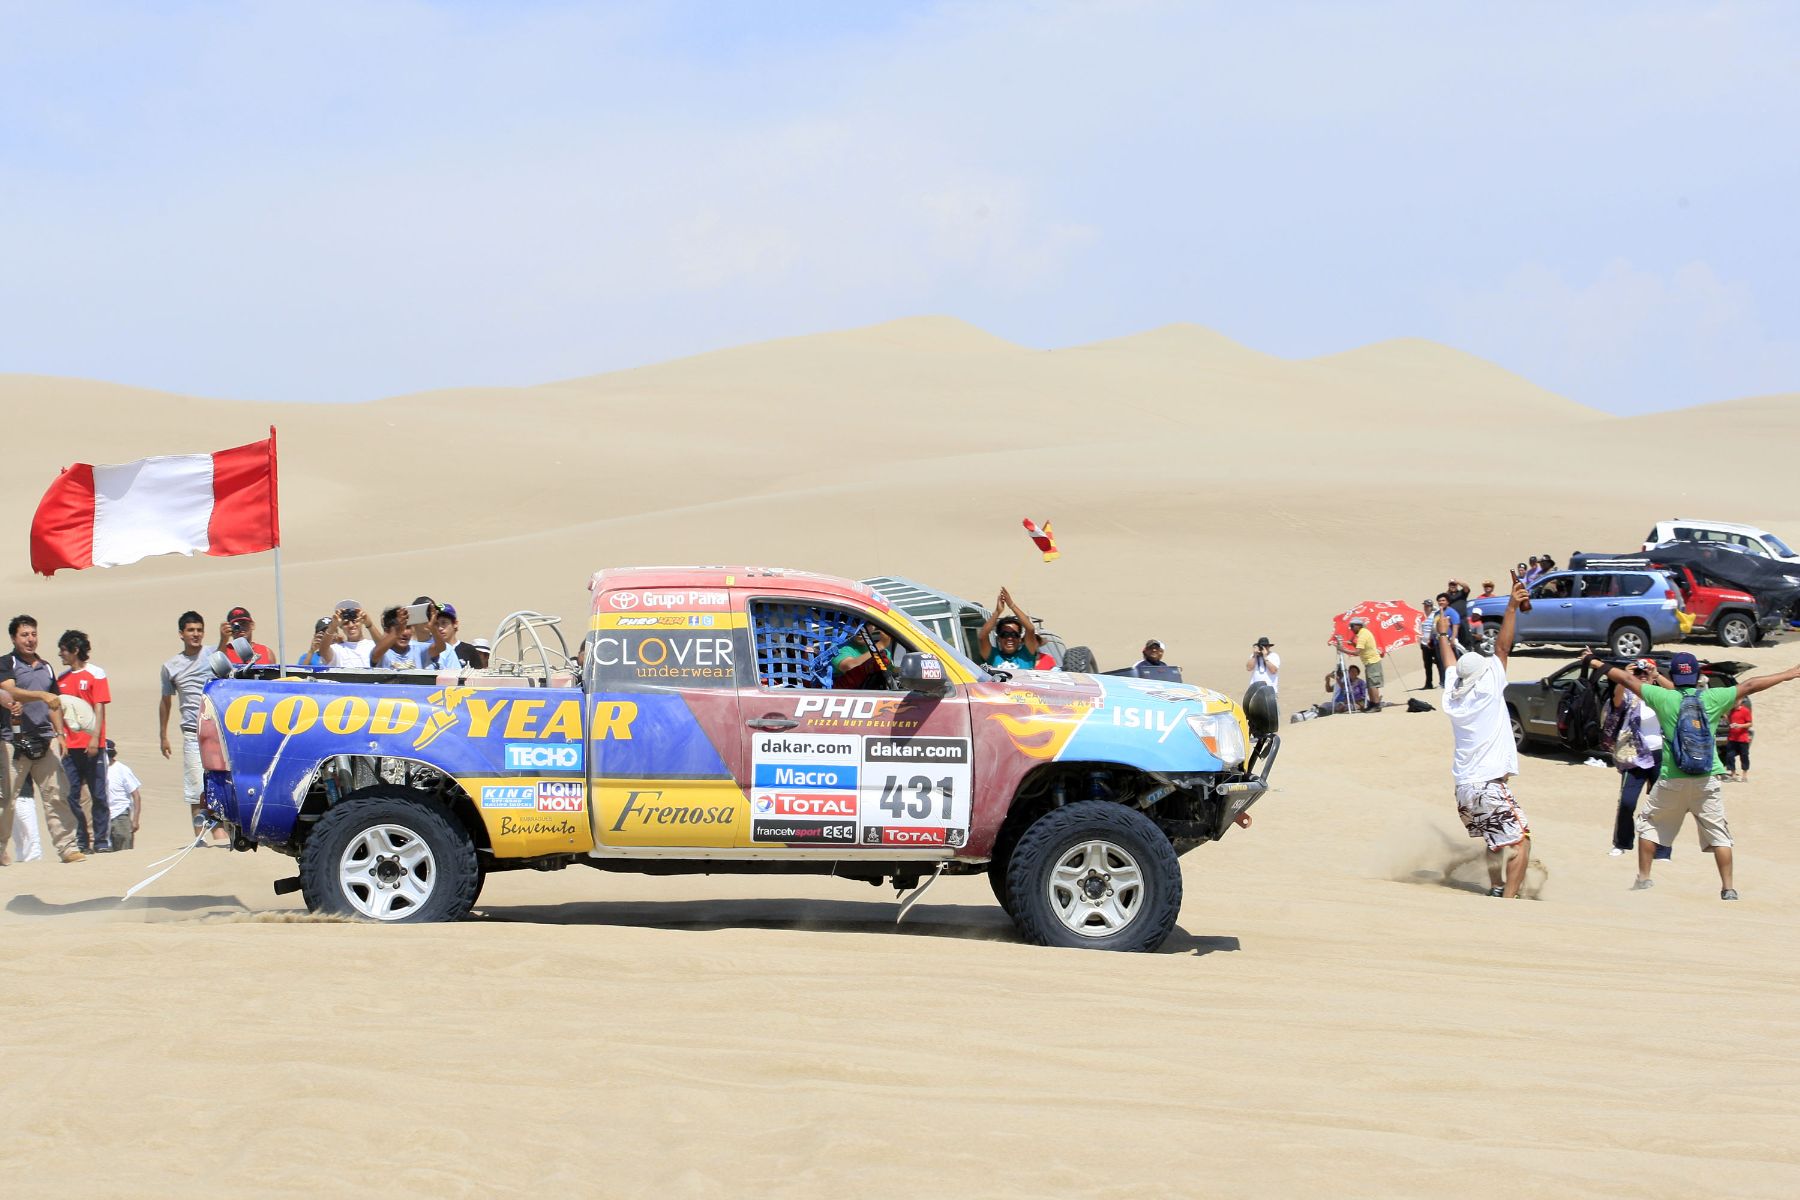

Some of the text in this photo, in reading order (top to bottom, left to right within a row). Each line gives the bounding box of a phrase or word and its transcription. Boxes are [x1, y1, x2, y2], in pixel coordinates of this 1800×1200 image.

[642, 591, 686, 608] Grupo
[593, 637, 733, 666] CLOVER
[636, 664, 735, 678] underwear
[923, 670, 939, 678] MOLY
[794, 696, 877, 719] PHD
[843, 719, 863, 727] HUT
[866, 720, 919, 728] DELIVERY
[761, 739, 852, 754] dakar.com
[870, 742, 962, 758] dakar.com
[508, 746, 578, 767] TECHO
[775, 768, 838, 785] Macro
[484, 788, 534, 798] KING
[539, 783, 581, 797] LIQUI
[879, 775, 953, 820] 431
[539, 797, 583, 810] MOLY
[609, 791, 735, 832] Frenosa
[500, 816, 576, 836] Benvenuto
